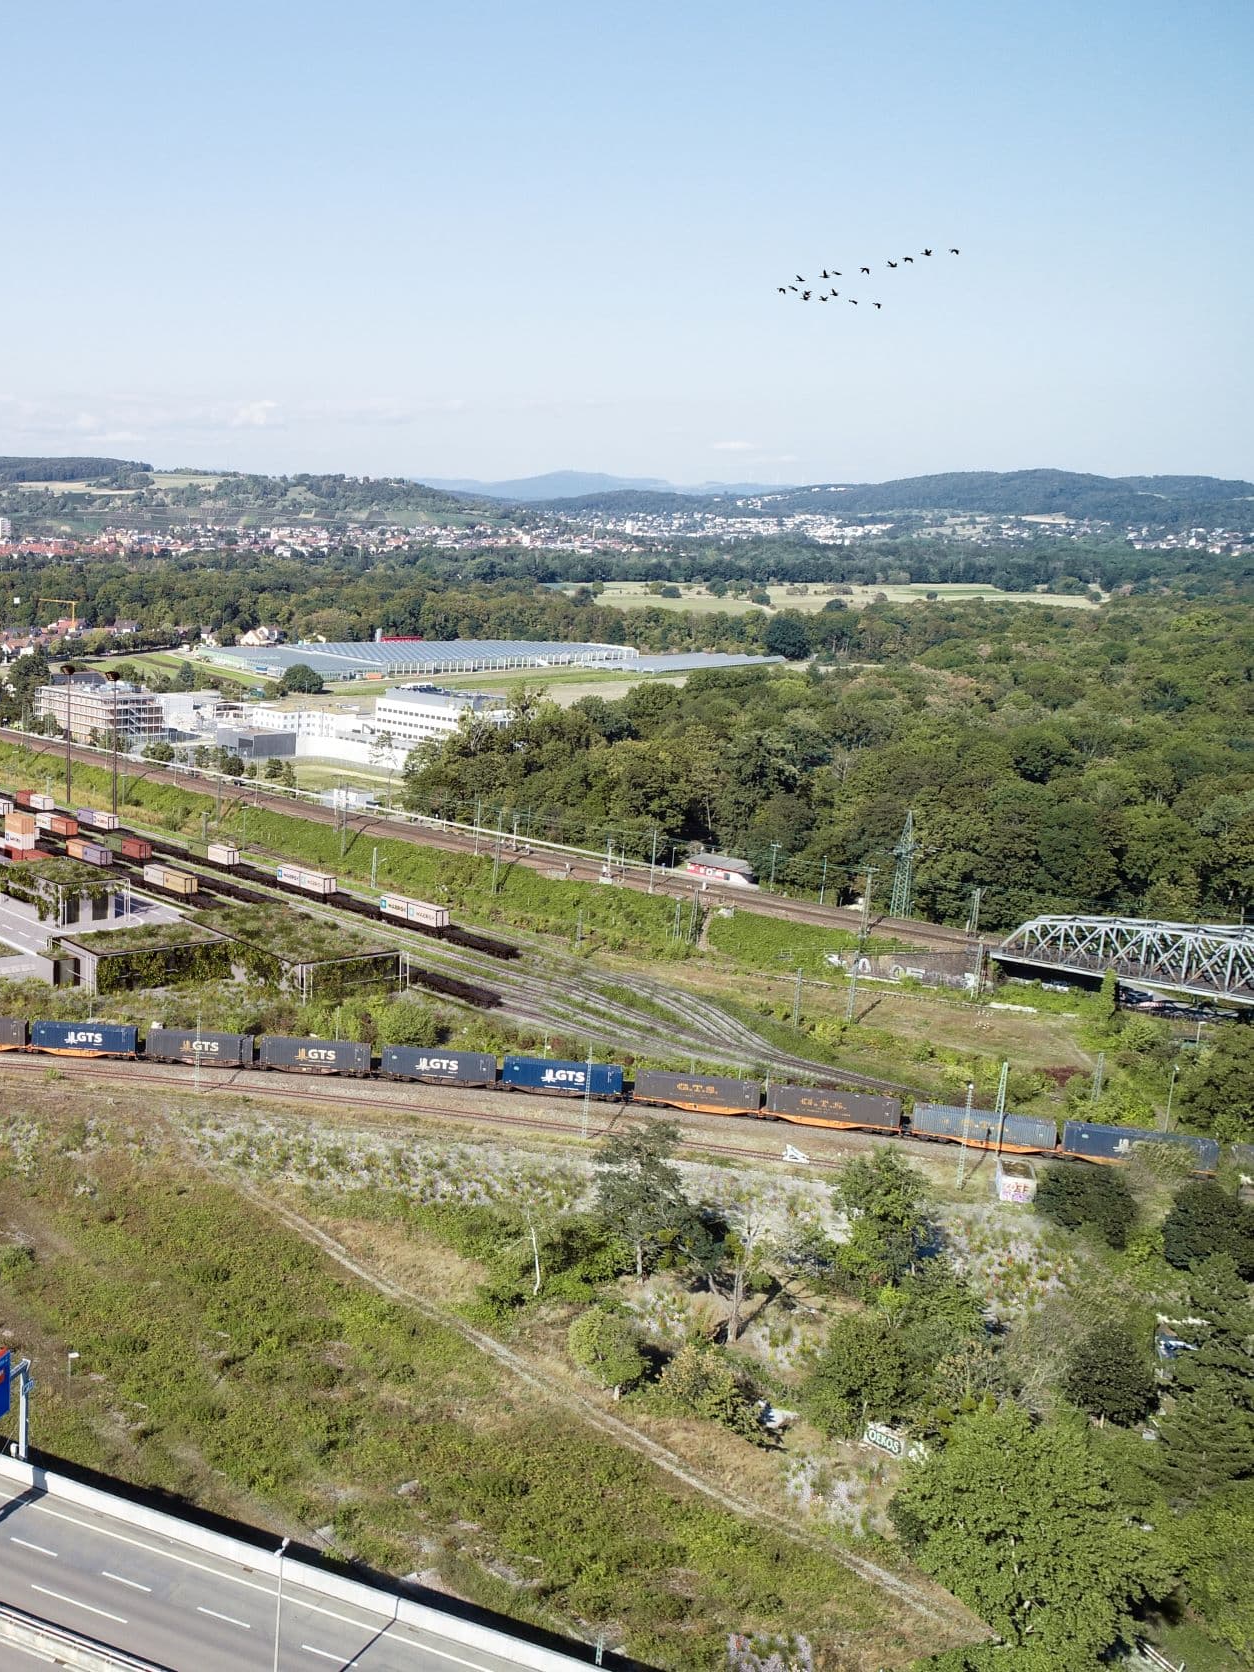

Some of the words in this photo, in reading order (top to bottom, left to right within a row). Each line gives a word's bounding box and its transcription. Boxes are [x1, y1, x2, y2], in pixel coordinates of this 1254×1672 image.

[77, 1032, 103, 1043] GTS
[192, 1041, 219, 1052] GTS
[308, 1049, 336, 1060] GTS
[429, 1058, 459, 1071] GTS
[555, 1070, 585, 1083] GTS
[868, 1429, 899, 1453] OEKOS
